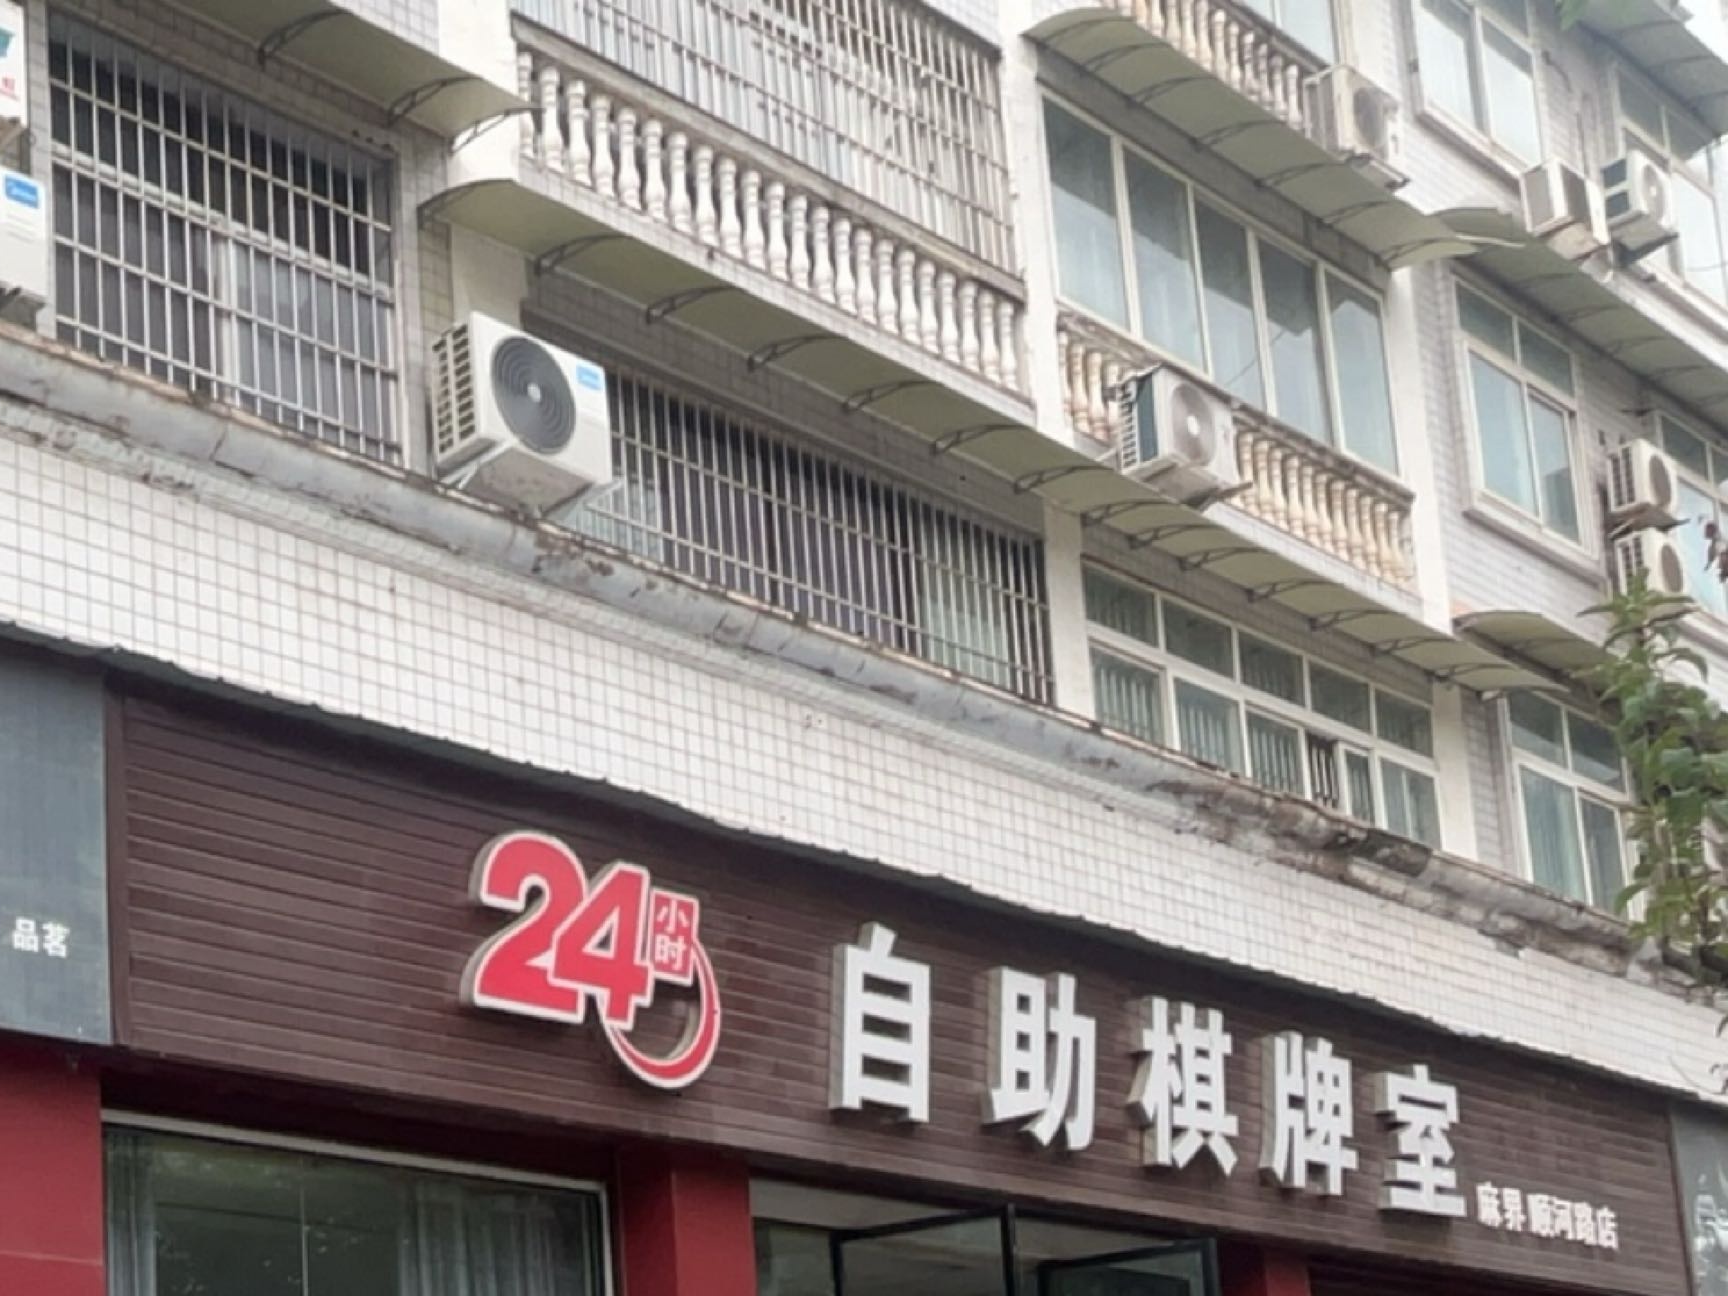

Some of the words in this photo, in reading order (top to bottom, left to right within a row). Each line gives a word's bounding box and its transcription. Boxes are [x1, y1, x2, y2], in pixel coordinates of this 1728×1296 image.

[11, 915, 70, 959] 品茗
[473, 831, 655, 1032] 24
[654, 898, 690, 972] 小时
[829, 921, 1468, 1219] 自助棋牌室
